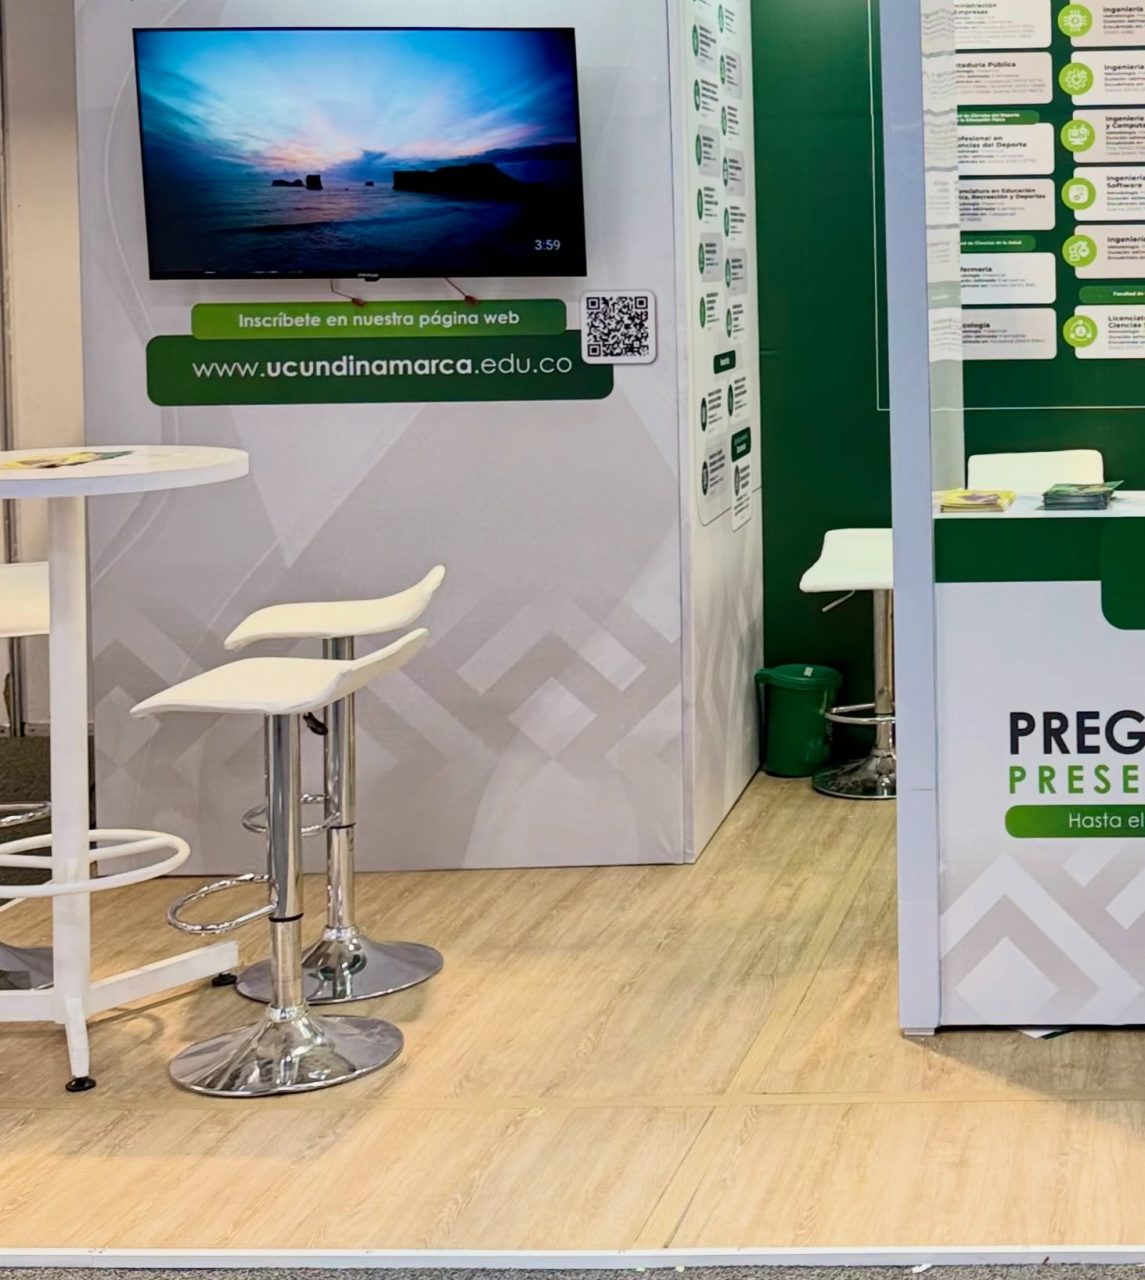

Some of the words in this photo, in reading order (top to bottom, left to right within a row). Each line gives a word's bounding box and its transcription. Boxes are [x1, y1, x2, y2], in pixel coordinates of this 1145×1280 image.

[1103, 6, 1144, 14] Ingeniería
[534, 239, 561, 252] 3:59
[238, 312, 321, 327] Inscríbete
[326, 316, 348, 327] en
[352, 314, 414, 327] nuestra
[419, 310, 480, 330] página
[485, 311, 520, 326] web
[192, 353, 573, 379] www.ucundinamarca.edu.co
[1068, 812, 1122, 829] Hasta
[1128, 812, 1145, 829] el
